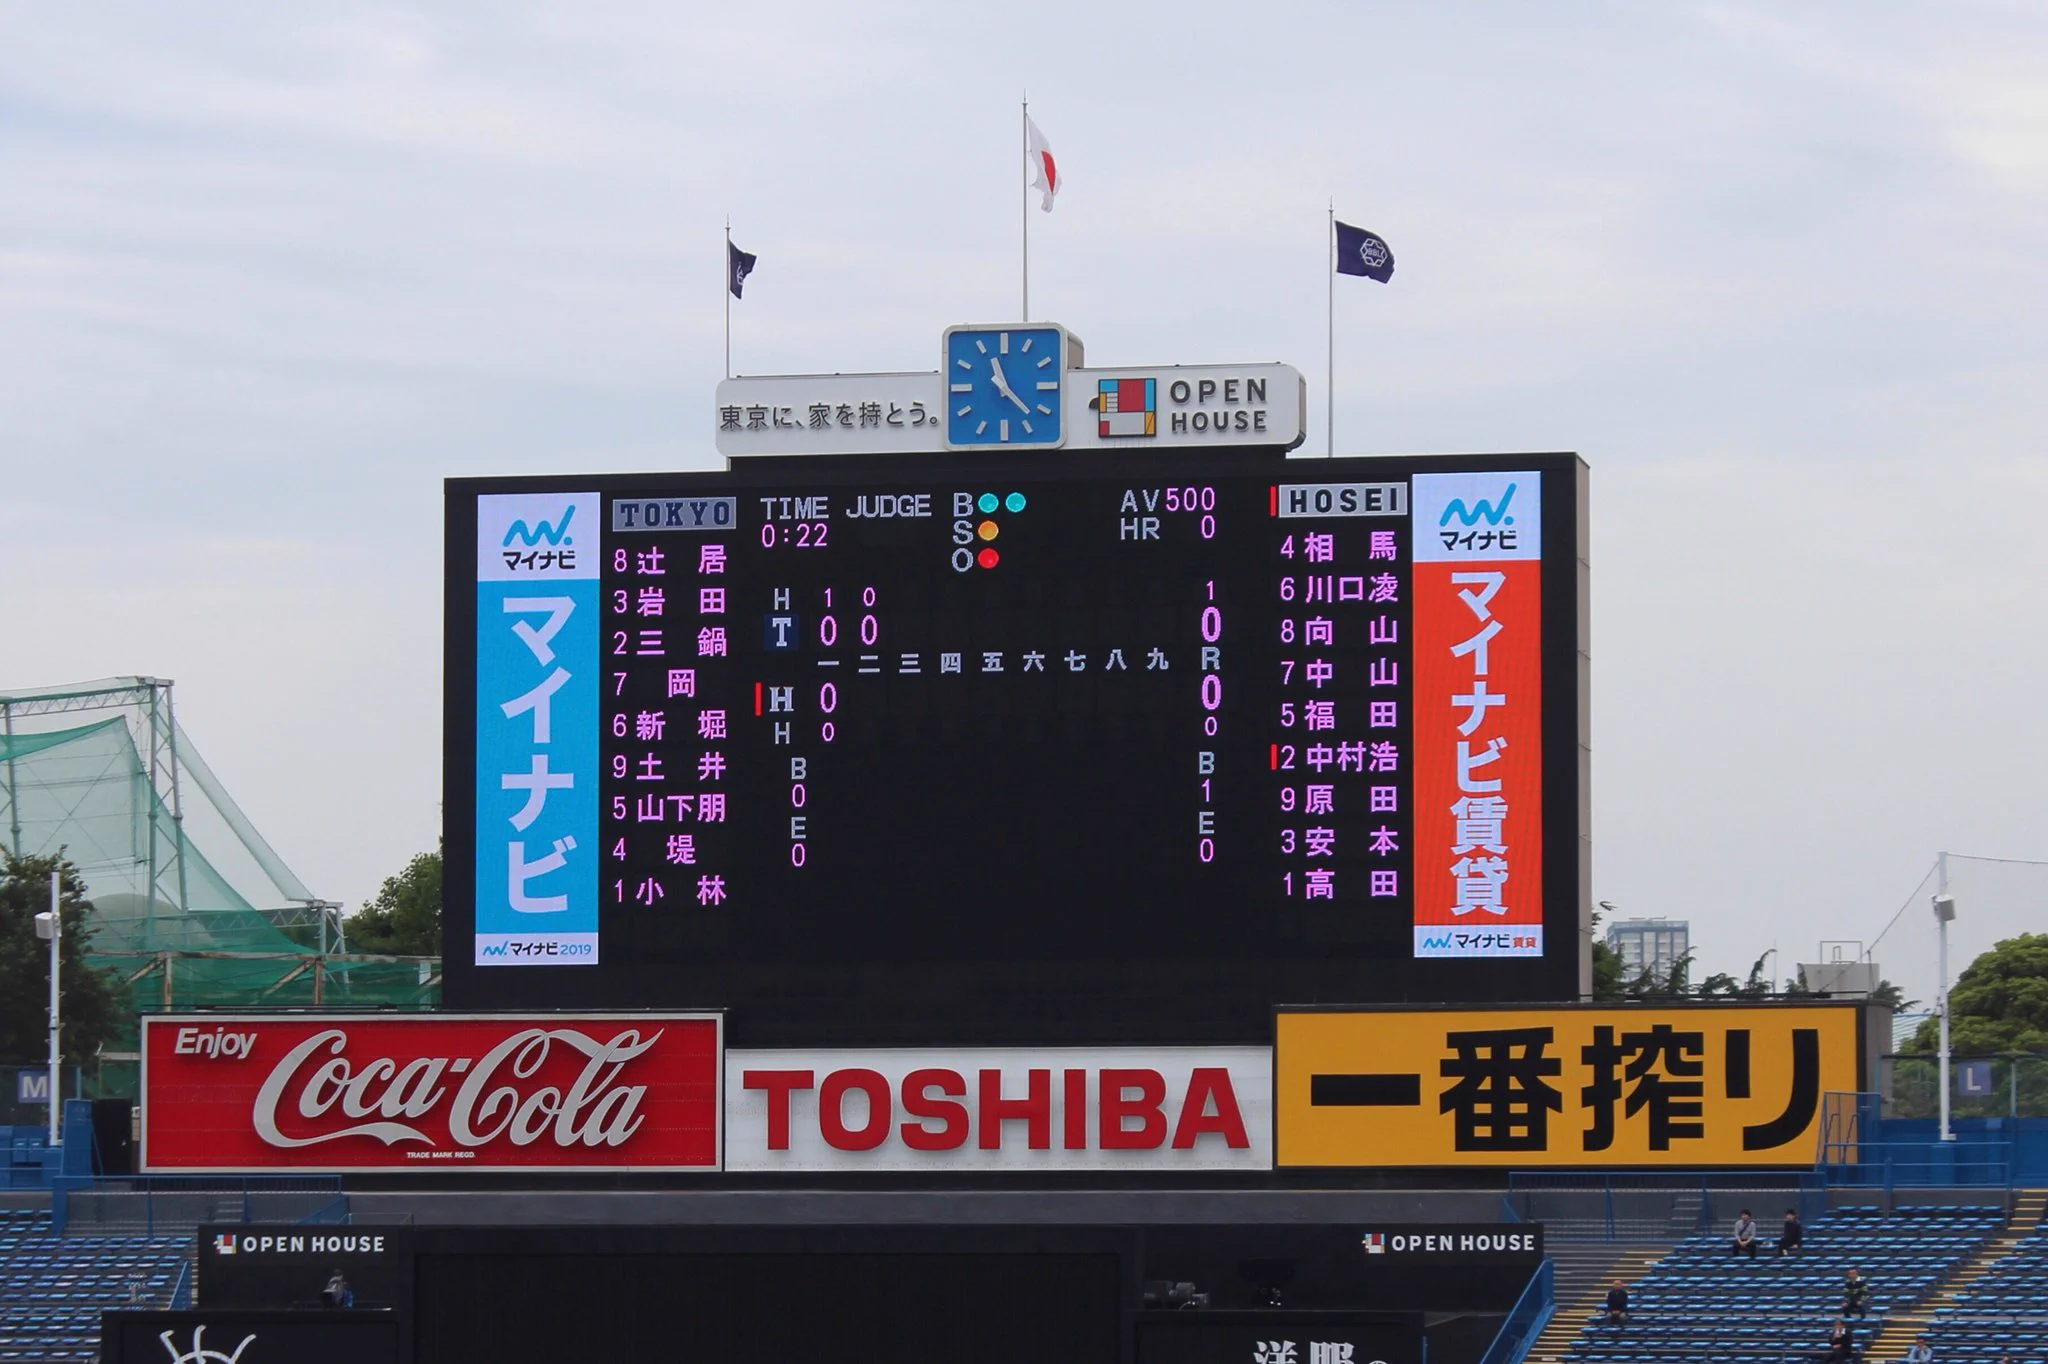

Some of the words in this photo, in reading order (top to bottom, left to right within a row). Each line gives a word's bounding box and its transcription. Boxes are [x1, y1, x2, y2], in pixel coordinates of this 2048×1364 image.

[1170, 379, 1266, 405] OPEN
[720, 402, 938, 431] 東京に、家を持とう。
[1172, 411, 1266, 433] HOUSE
[760, 497, 829, 520] TIME
[846, 494, 932, 518] JUDGE
[954, 493, 973, 517] B
[1121, 489, 1159, 512] AV
[1166, 487, 1215, 511] 500
[1291, 488, 1396, 513] HOSEI
[621, 502, 729, 527] TOKYO
[762, 523, 827, 547] 0:22
[953, 520, 973, 544] S
[1121, 517, 1159, 540] HR
[1202, 515, 1215, 538] 0
[1281, 535, 1294, 558] 4
[1440, 531, 1517, 550] マイナビ
[503, 551, 575, 570] マイナビ
[614, 549, 627, 572] 8
[775, 588, 789, 610] H
[825, 588, 831, 607] 1
[864, 587, 875, 606] 0
[1207, 581, 1213, 600] 1
[1281, 577, 1294, 601] 6
[1306, 572, 1398, 603] 川口凌
[614, 590, 627, 613] 3
[772, 618, 791, 646] T
[821, 616, 836, 646] 0
[861, 615, 877, 645] 0
[1202, 607, 1221, 642] 0
[1281, 619, 1294, 643] 8
[614, 631, 627, 654] 2
[1202, 647, 1220, 670] R
[614, 672, 627, 695] 7
[668, 669, 694, 697] 岡
[1281, 661, 1295, 684] 7
[770, 687, 794, 712] H
[821, 683, 836, 713] 0
[1202, 675, 1221, 710] 0
[614, 714, 626, 737] 6
[1205, 717, 1217, 736] 0
[1281, 703, 1295, 727] 5
[775, 722, 789, 744] H
[822, 723, 834, 741] 0
[1450, 571, 1508, 915] マイナビ賃貸
[500, 596, 577, 913] マイナビ
[1199, 752, 1214, 774] B
[1281, 745, 1295, 769] 2
[1307, 741, 1398, 772] 中村浩
[614, 755, 626, 778] 9
[792, 758, 806, 779] B
[792, 784, 805, 807] 0
[1202, 779, 1209, 802] 1
[1281, 787, 1295, 811] 9
[613, 796, 626, 819] 5
[638, 794, 725, 822] 山下朋
[791, 817, 806, 839] E
[1199, 812, 1214, 834] E
[613, 838, 626, 860] 4
[667, 835, 696, 864] 堤
[1200, 839, 1213, 862] 0
[1281, 830, 1295, 853] 3
[792, 844, 805, 866] 0
[615, 880, 622, 902] 1
[1284, 872, 1291, 895] 1
[511, 943, 557, 955] マイナビ
[560, 944, 591, 955] 2019
[1456, 934, 1510, 948] マイナビ
[175, 1027, 257, 1059] Enjoy
[22, 1076, 49, 1098] M
[251, 1027, 666, 1148] Coca-Cola
[1310, 1023, 1821, 1152] 一番搾り
[1966, 1068, 1981, 1090] L
[741, 1067, 1251, 1151] TOSHIBA
[243, 1236, 305, 1253] OPEN
[311, 1236, 385, 1253] HOUSE
[1391, 1234, 1453, 1251] OPEN
[1460, 1234, 1535, 1250] HOUSE
